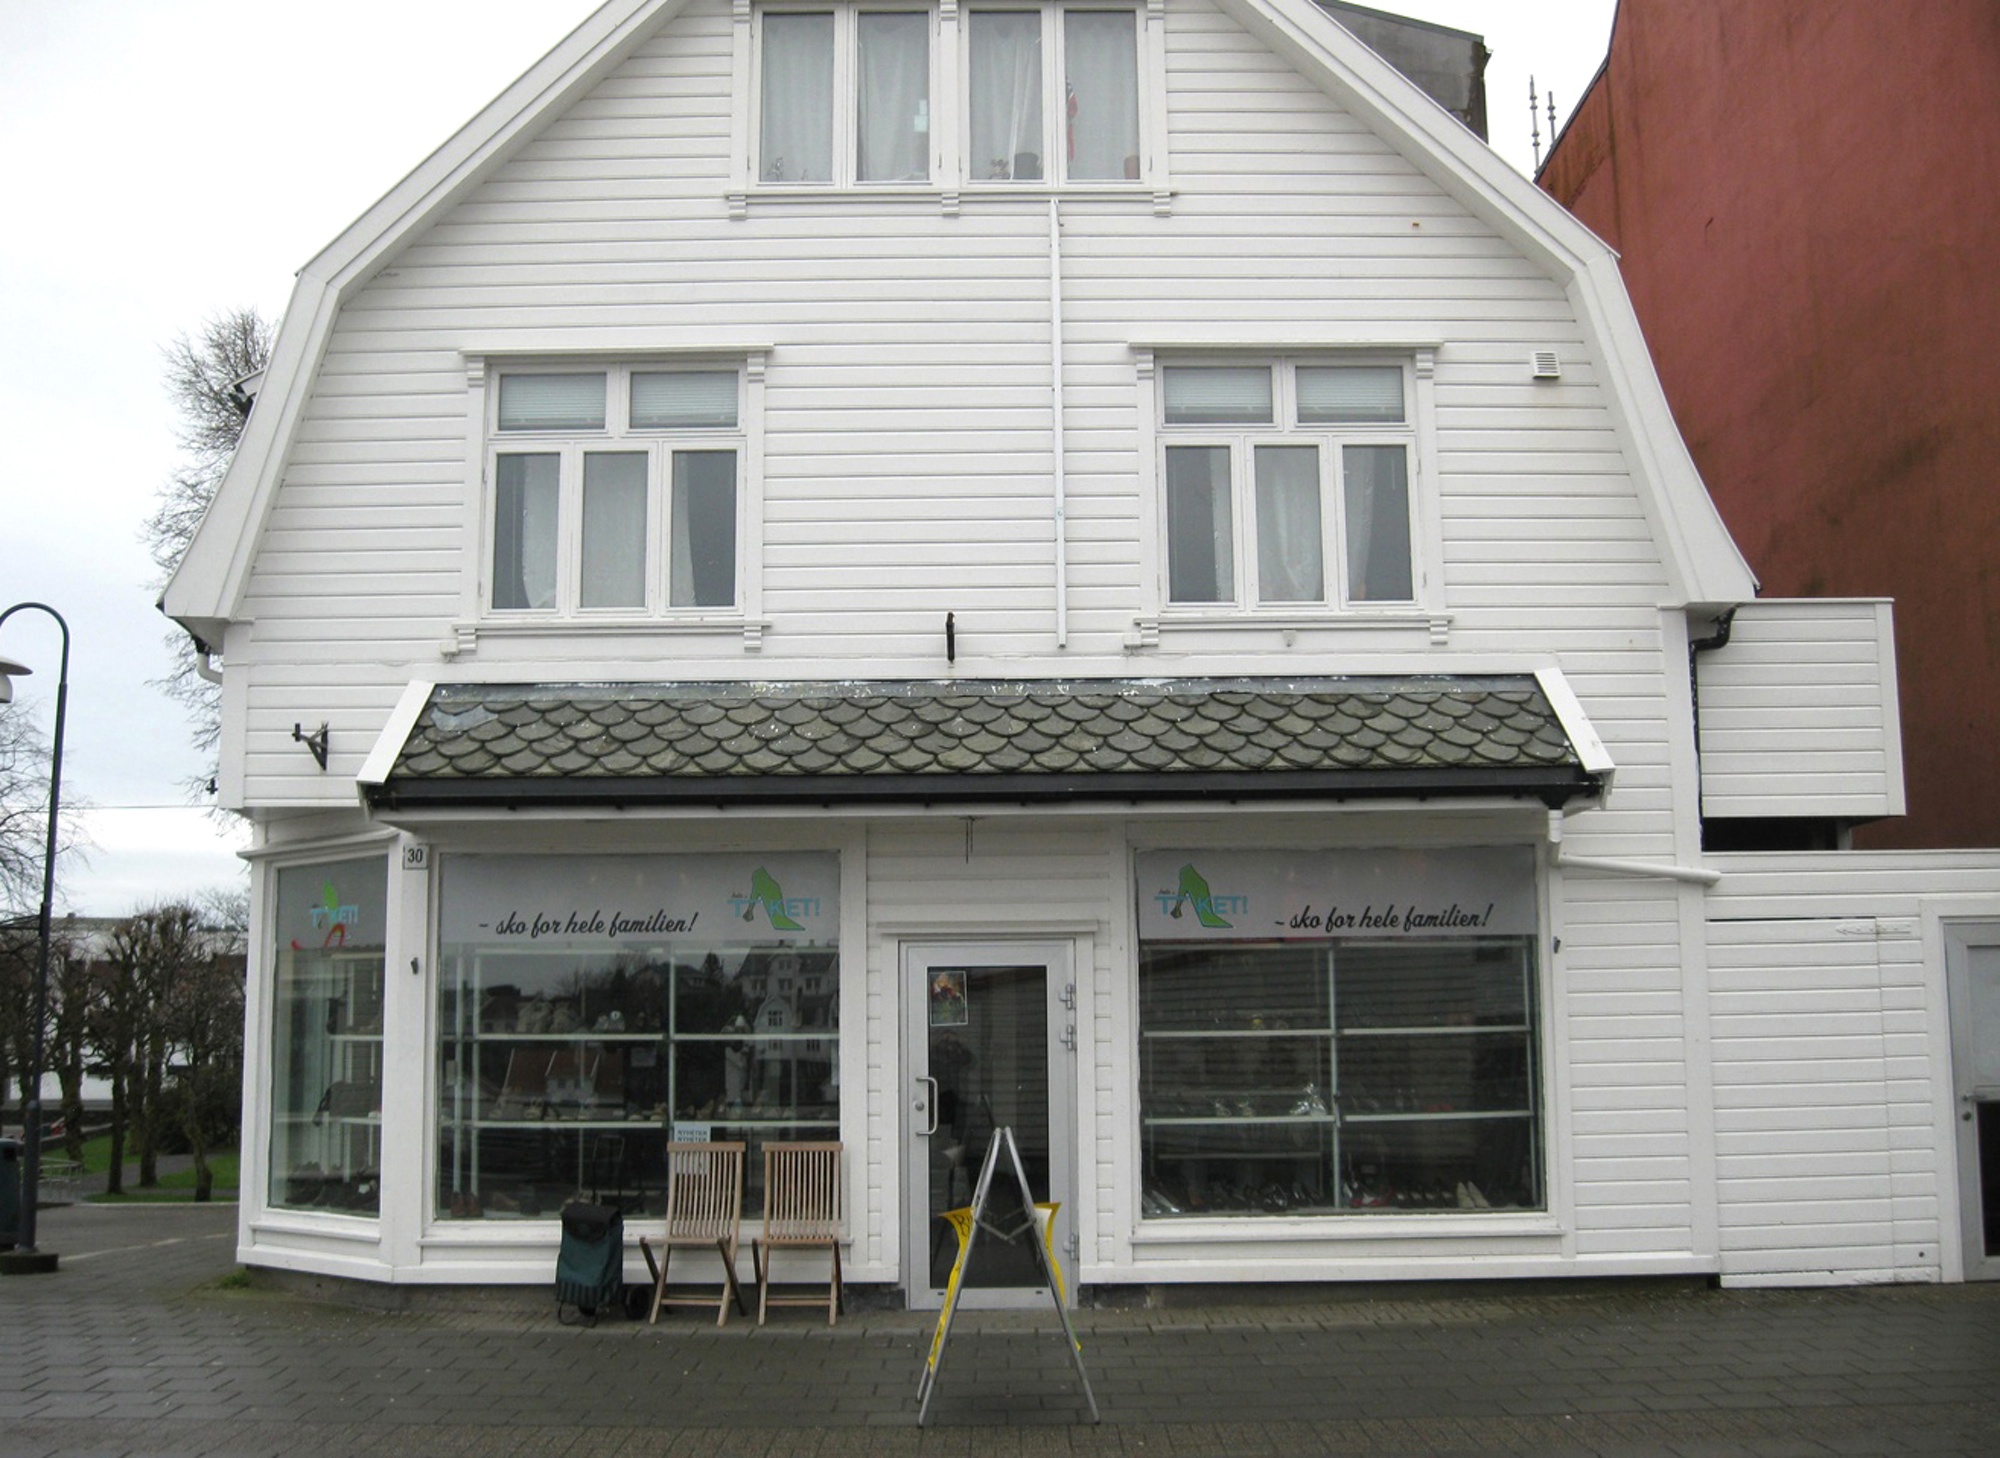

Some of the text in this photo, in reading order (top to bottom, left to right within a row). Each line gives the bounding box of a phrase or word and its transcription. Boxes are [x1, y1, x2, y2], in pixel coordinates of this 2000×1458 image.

[407, 848, 423, 863] 30
[495, 910, 527, 935] sko
[530, 912, 561, 939] for
[564, 910, 605, 934] hele
[608, 908, 699, 938] familien!
[1289, 904, 1321, 929] sko
[1325, 905, 1356, 934] for
[1358, 904, 1399, 929] hele
[1403, 898, 1494, 932] familien!
